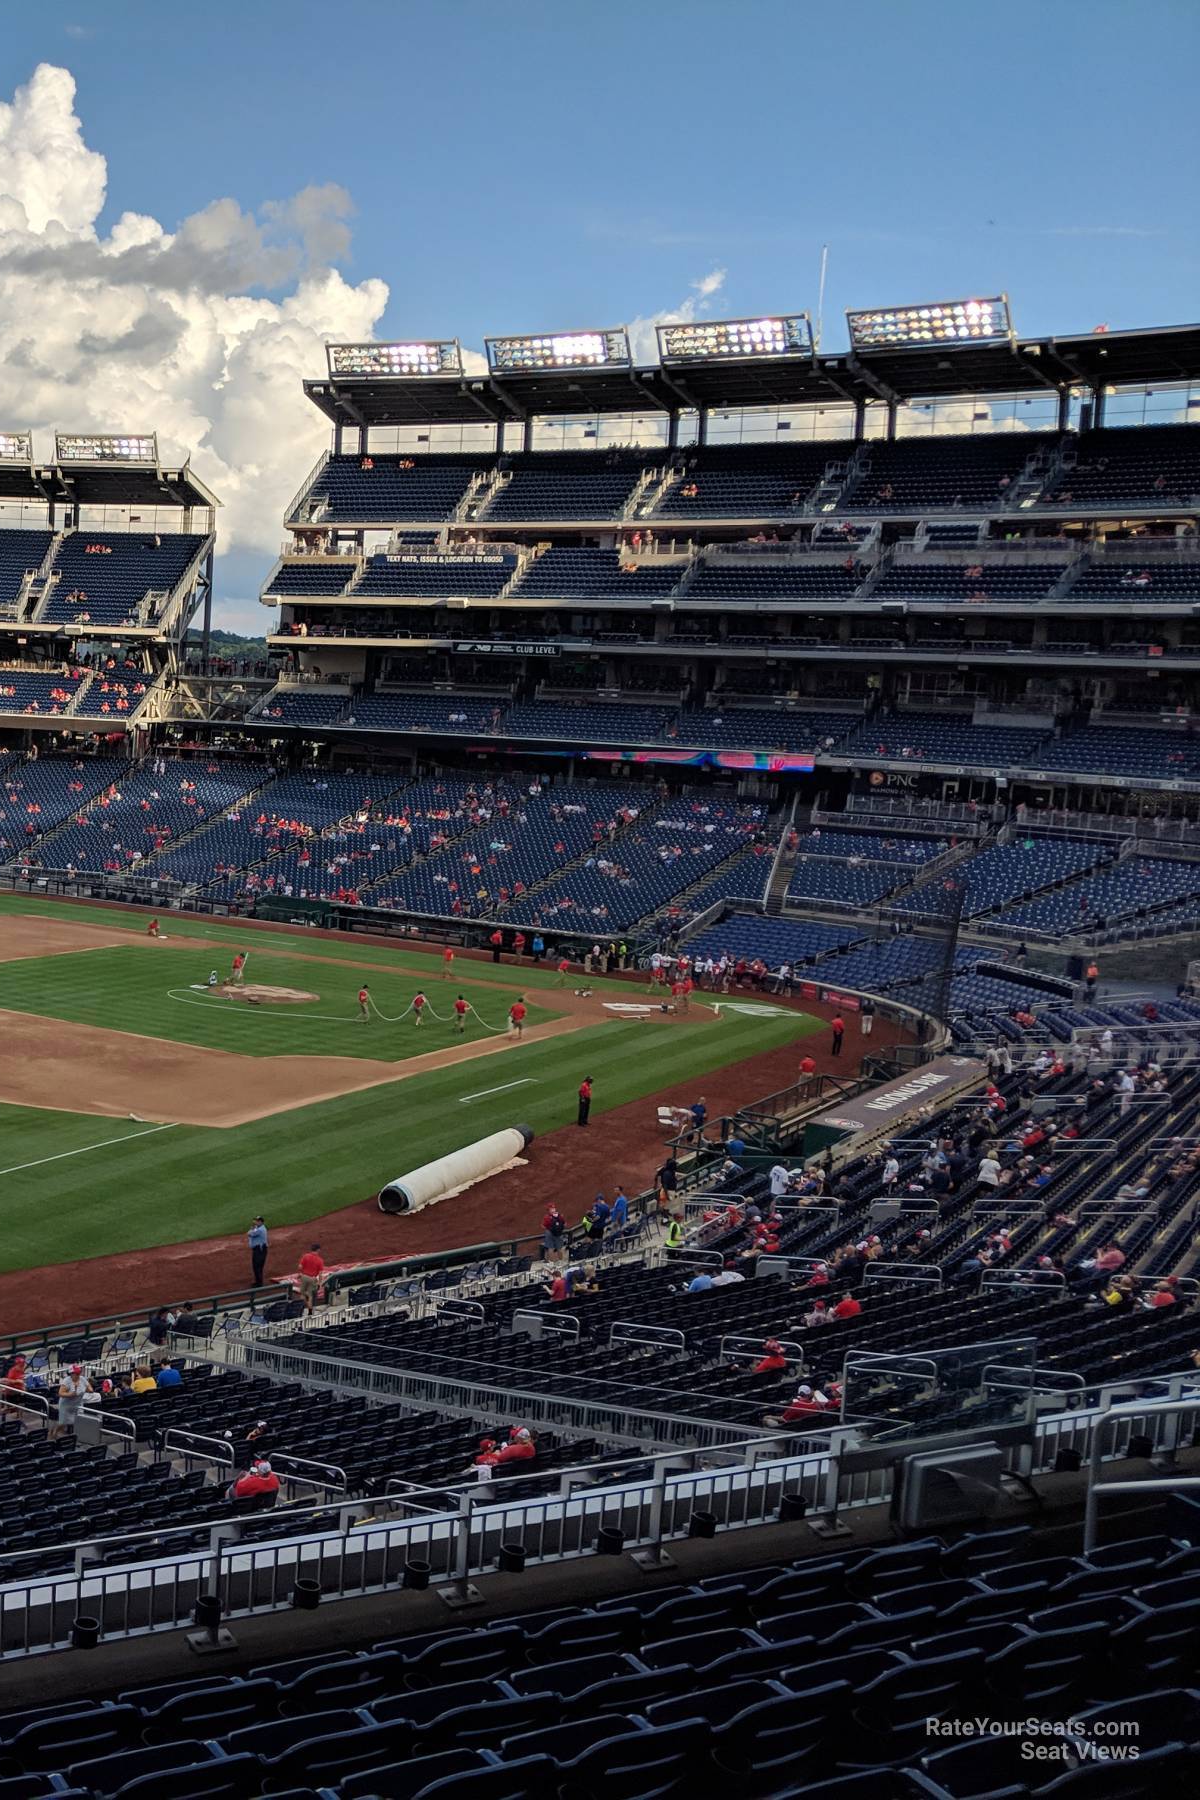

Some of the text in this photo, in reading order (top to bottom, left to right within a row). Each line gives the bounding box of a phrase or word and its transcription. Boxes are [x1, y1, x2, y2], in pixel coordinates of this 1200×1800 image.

[516, 645, 534, 653] CLUB
[535, 646, 556, 654] LEVEL
[887, 774, 918, 788] PNC
